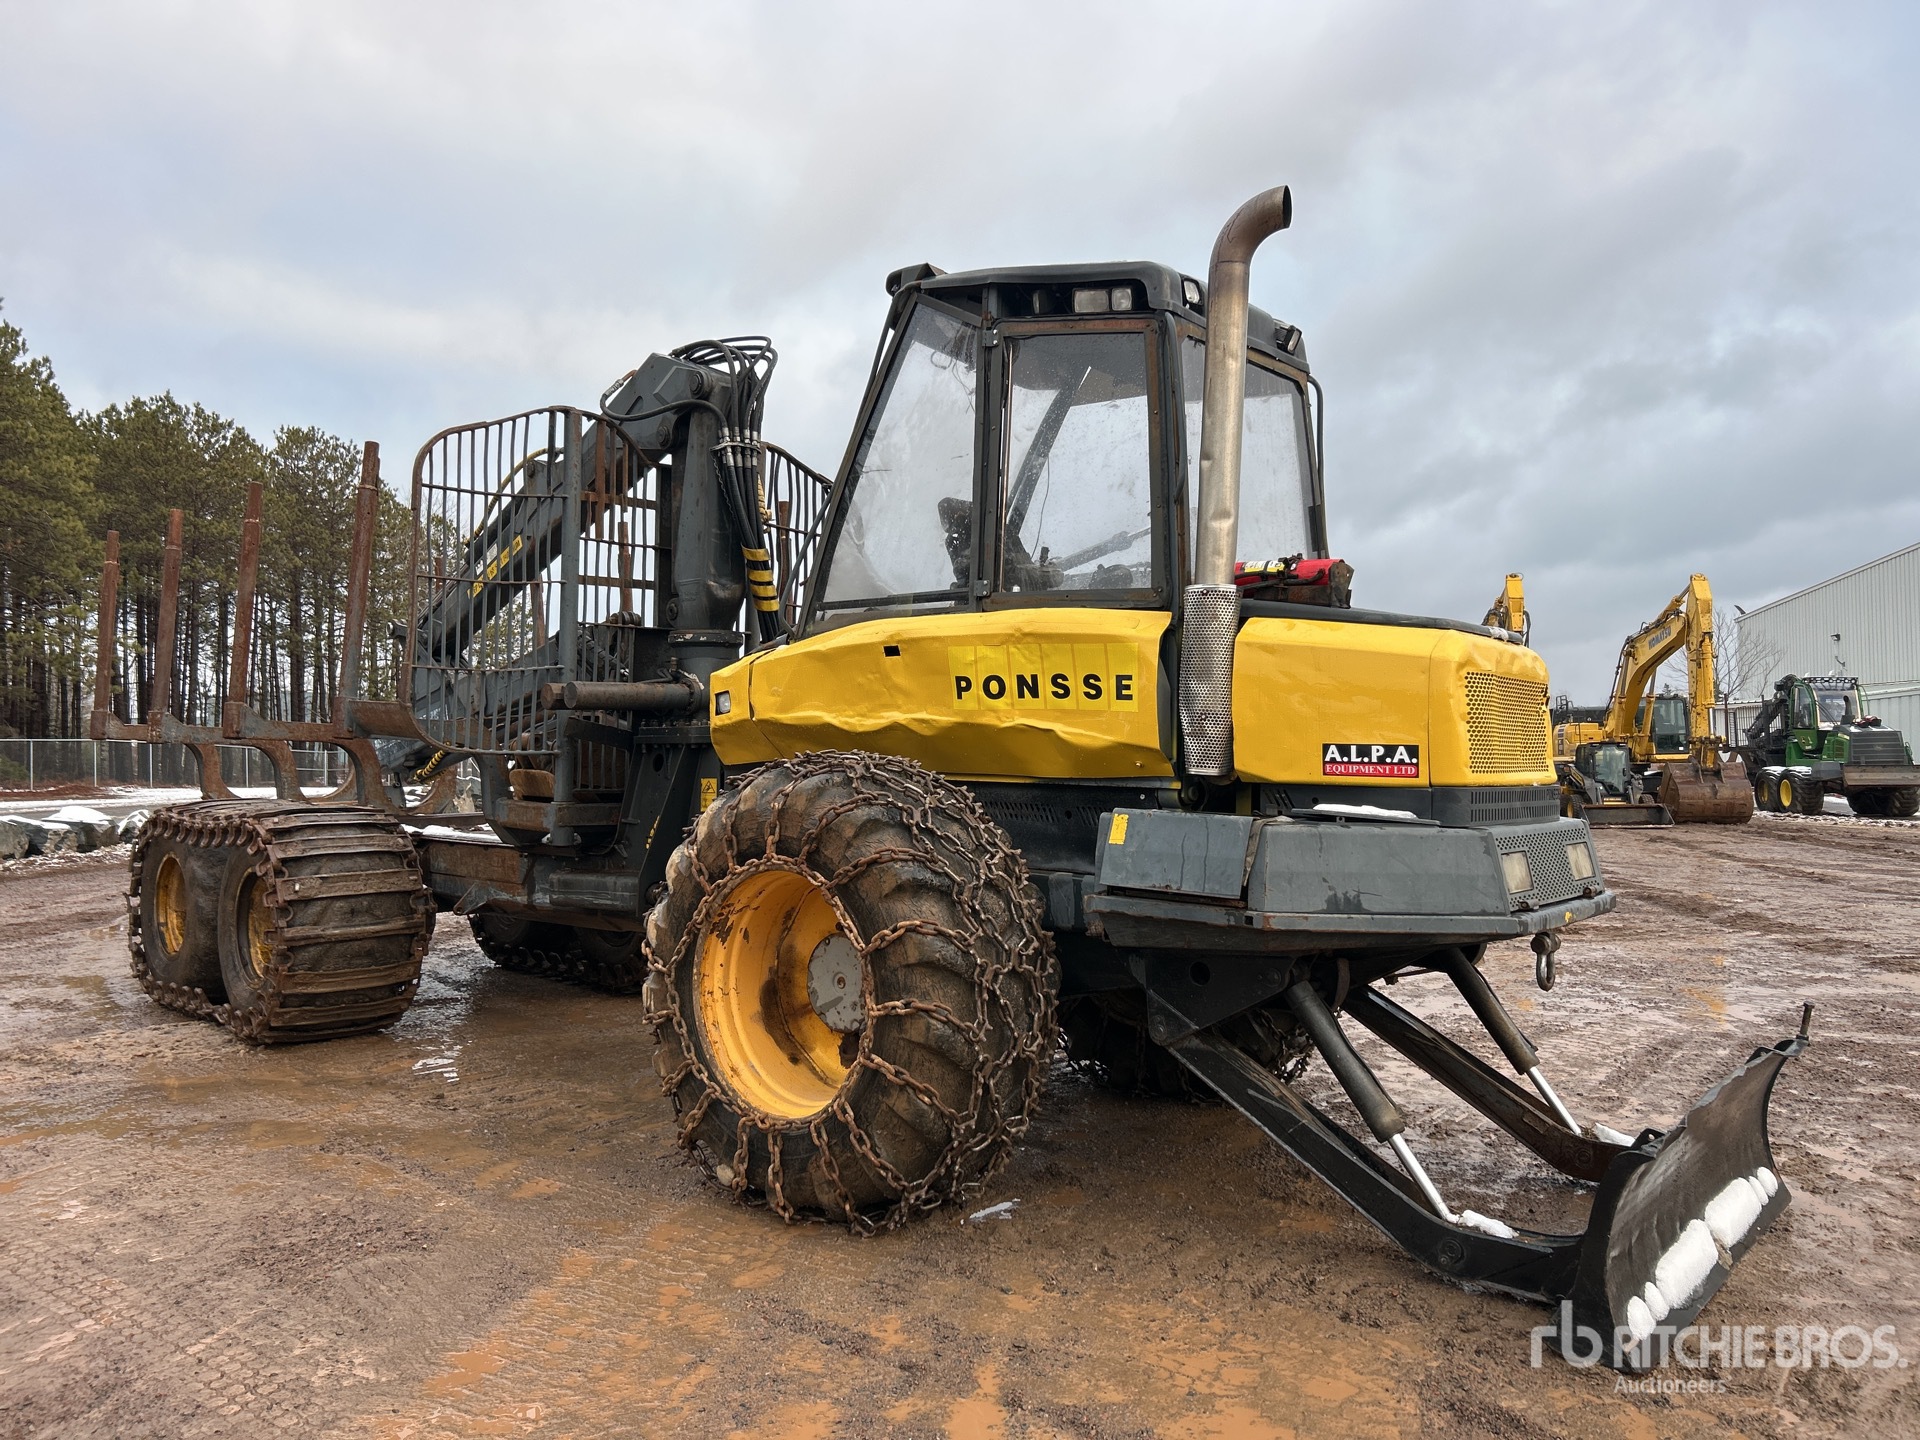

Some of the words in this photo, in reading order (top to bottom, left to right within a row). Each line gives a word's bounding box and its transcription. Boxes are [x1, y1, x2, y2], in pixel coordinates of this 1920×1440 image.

[954, 673, 1134, 701] PONSSE
[1324, 744, 1418, 764] A.L.P.A.
[1325, 764, 1391, 775] EQUIPMENT
[1393, 765, 1416, 775] LTD
